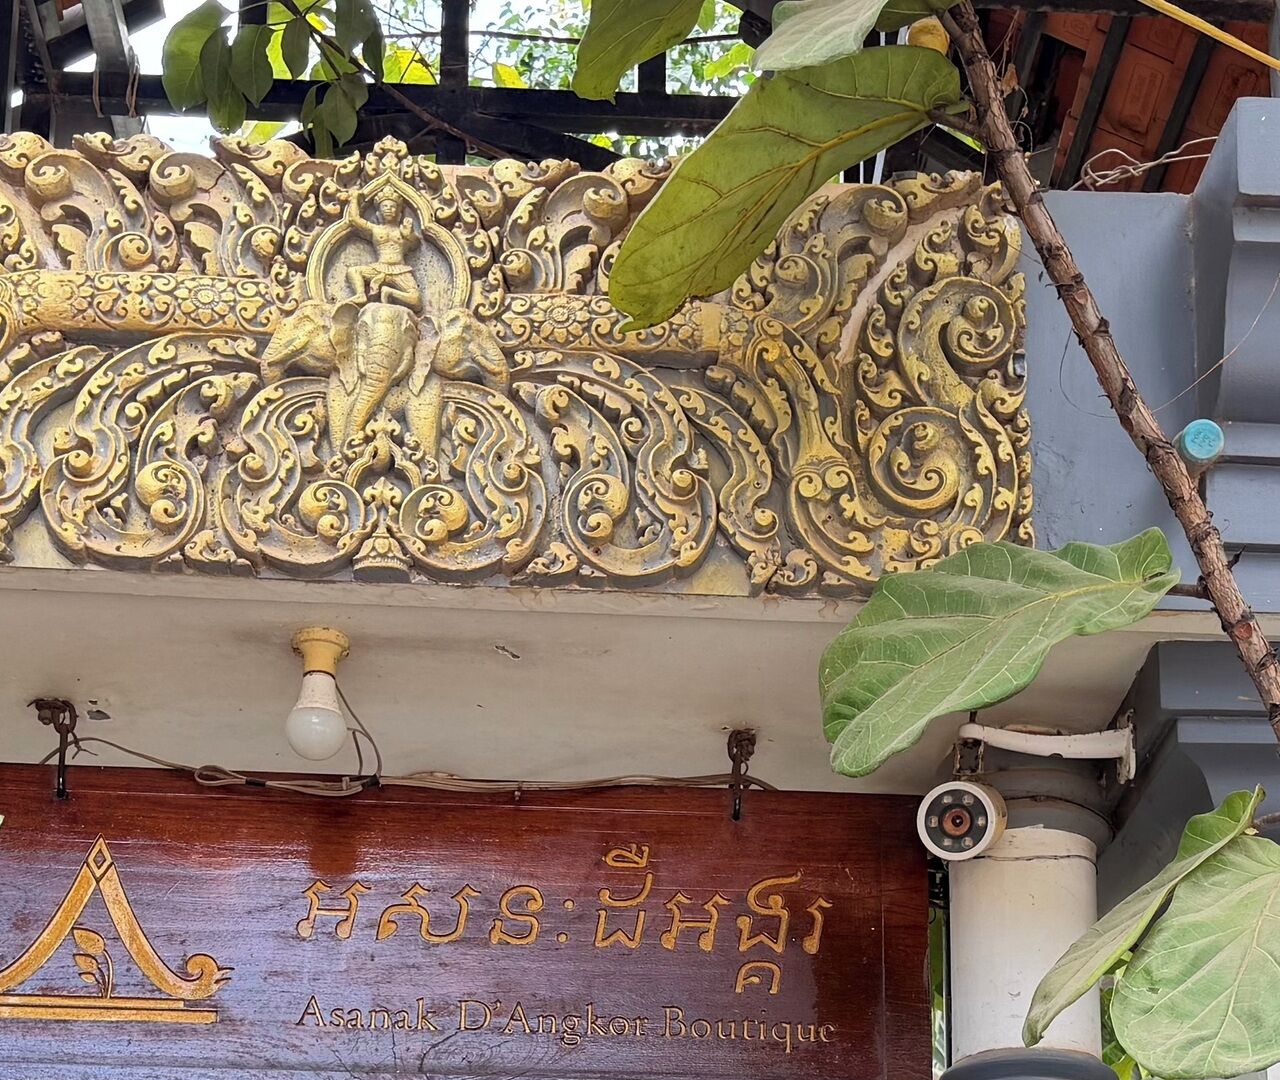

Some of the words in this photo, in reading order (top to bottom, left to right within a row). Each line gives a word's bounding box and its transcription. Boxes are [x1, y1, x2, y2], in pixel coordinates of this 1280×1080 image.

[295, 995, 438, 1031] Asanak
[458, 998, 649, 1050] D'Angkor
[661, 1004, 836, 1054] Boutique
